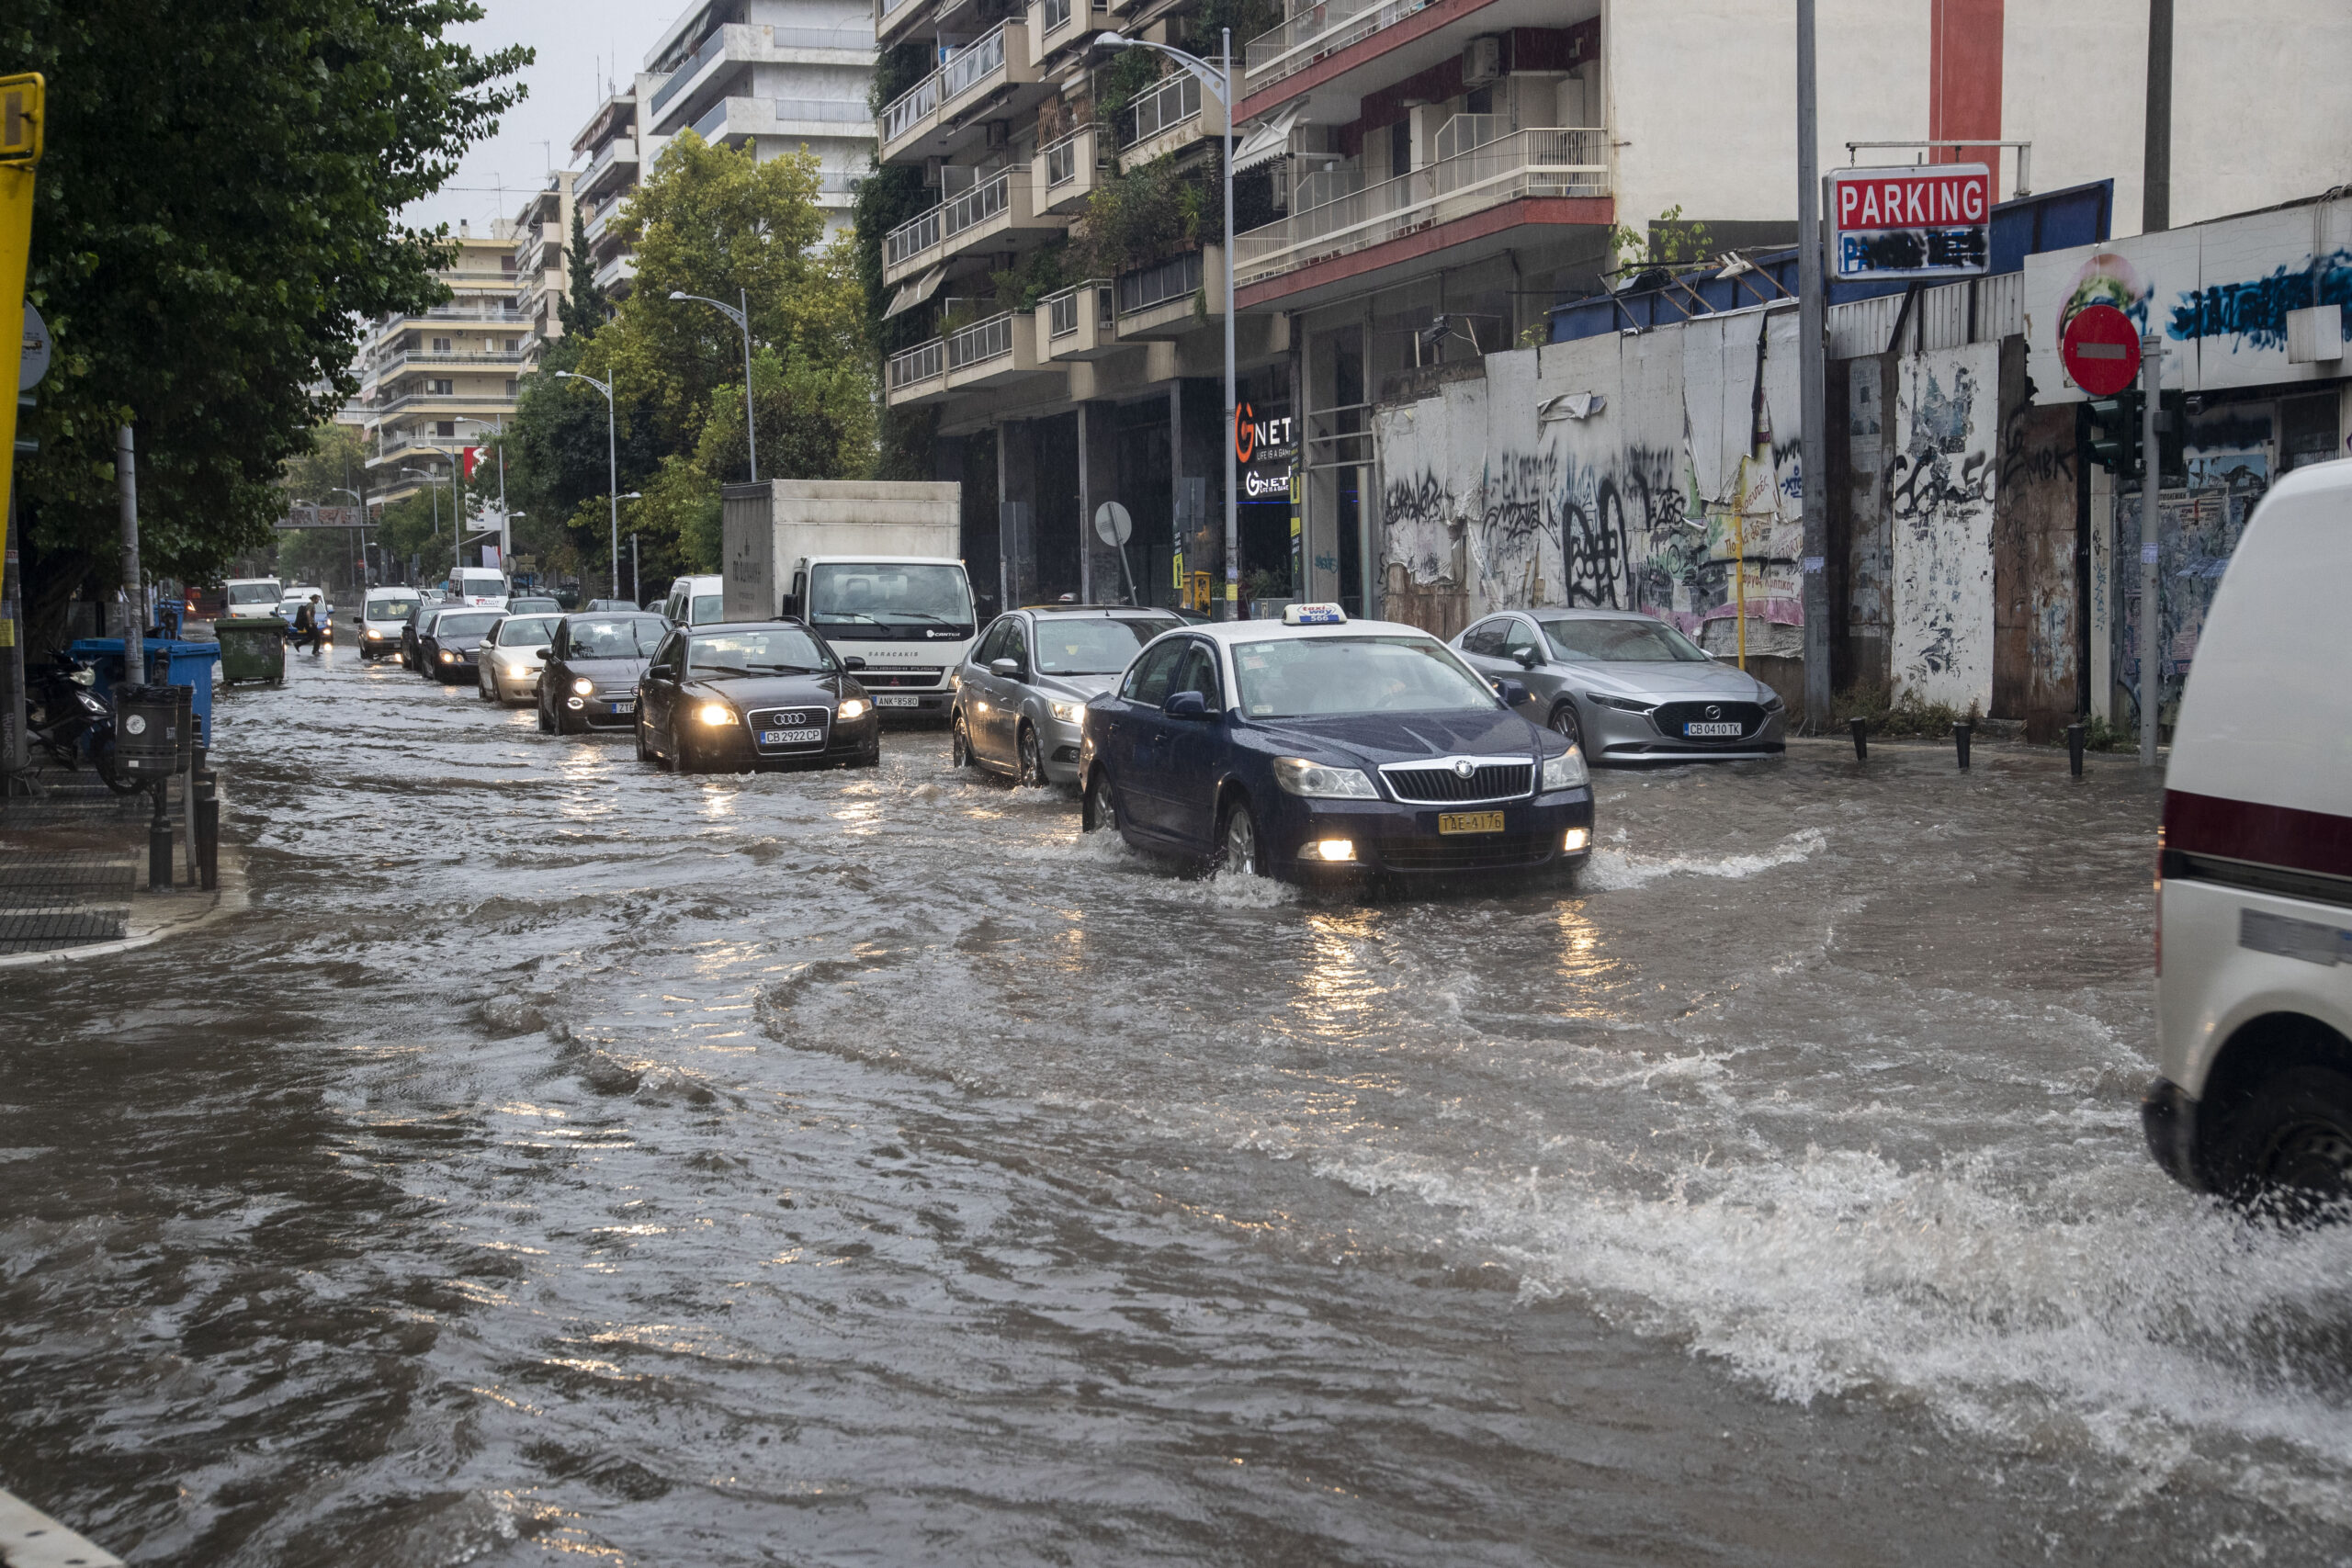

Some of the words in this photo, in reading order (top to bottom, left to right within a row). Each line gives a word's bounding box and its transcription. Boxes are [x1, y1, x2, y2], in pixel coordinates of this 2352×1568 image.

[1841, 180, 1983, 226] PARKING
[1257, 450, 1267, 461] LIFE
[1268, 449, 1273, 458] IS
[878, 697, 918, 705] ANK-8580
[766, 732, 780, 743] CB
[781, 731, 806, 742] 2922
[807, 729, 820, 740] CP
[1690, 724, 1702, 735] CB
[1704, 724, 1727, 735] 0410
[1727, 724, 1740, 735] TK
[1442, 814, 1502, 831] TAE-4176
